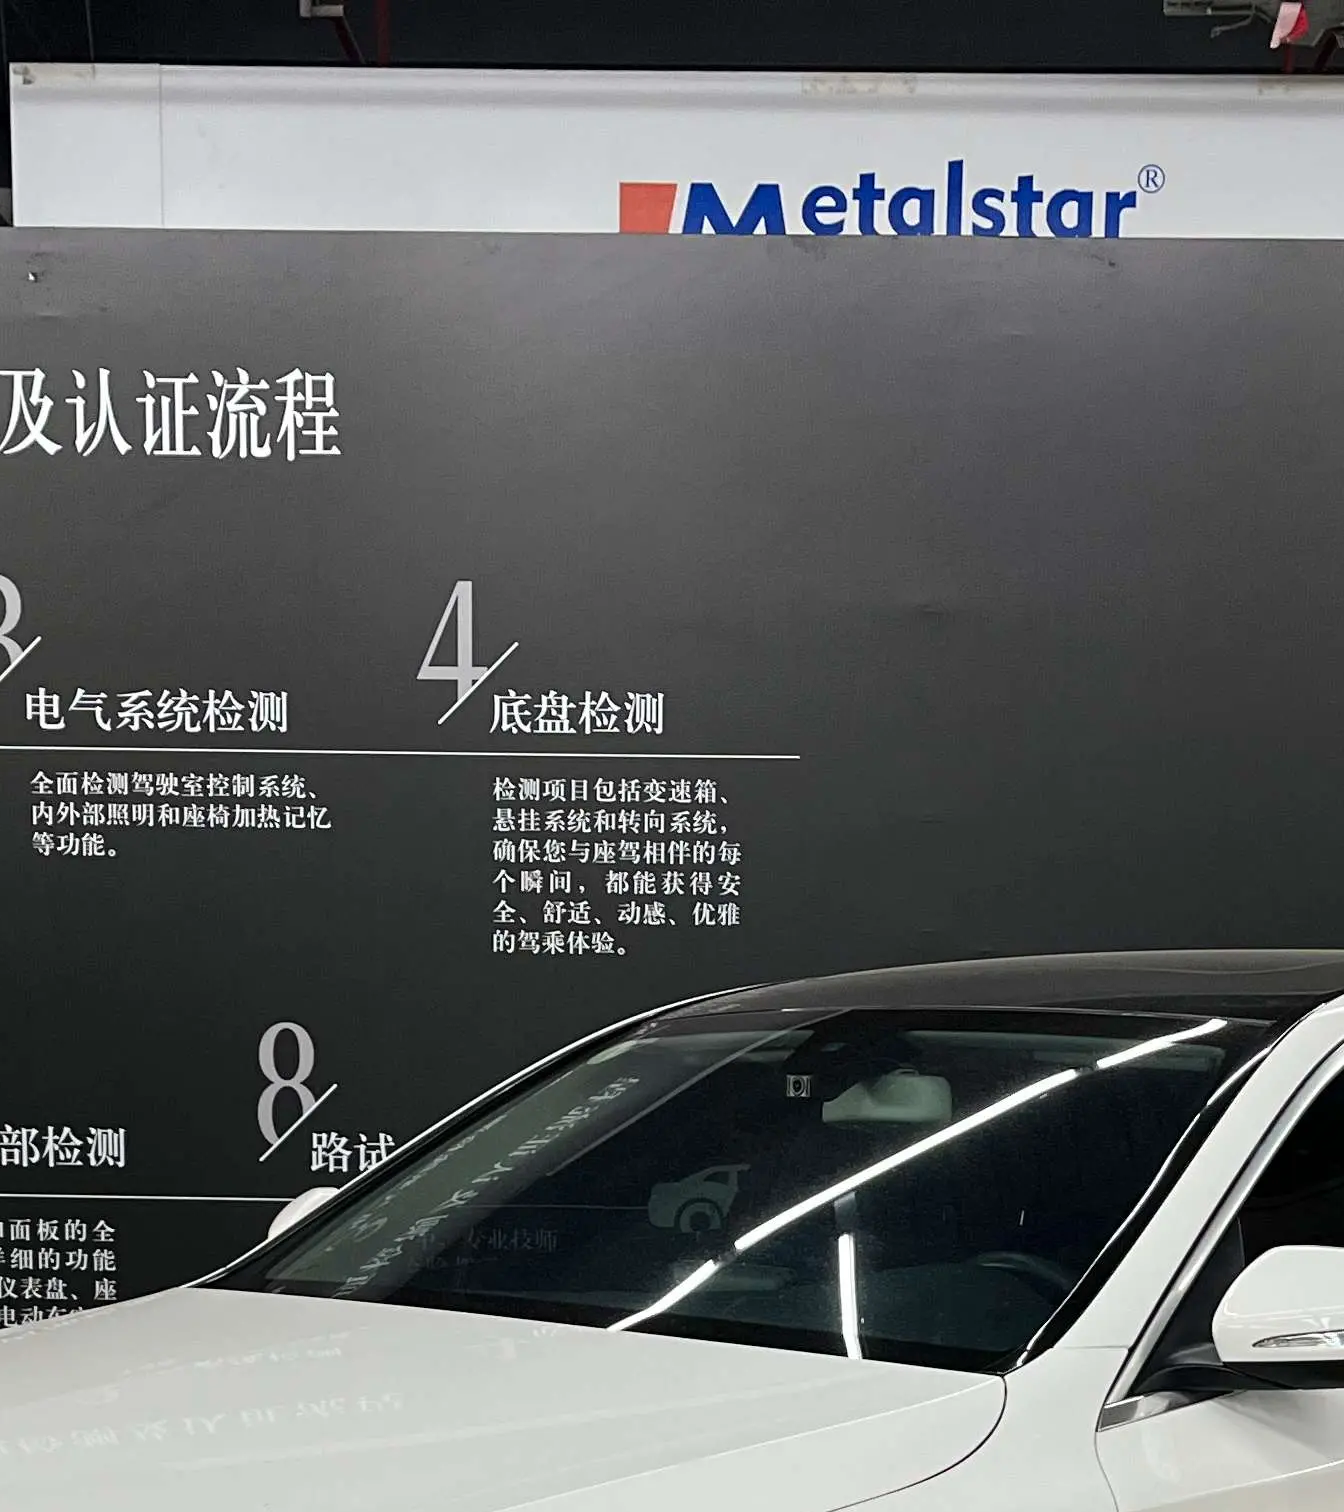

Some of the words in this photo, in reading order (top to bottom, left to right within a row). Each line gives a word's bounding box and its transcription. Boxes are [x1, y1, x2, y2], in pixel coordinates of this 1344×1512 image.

[25, 687, 288, 733] 电气系统检测
[489, 688, 665, 735] 底盘检测
[311, 1131, 396, 1174] 路试
